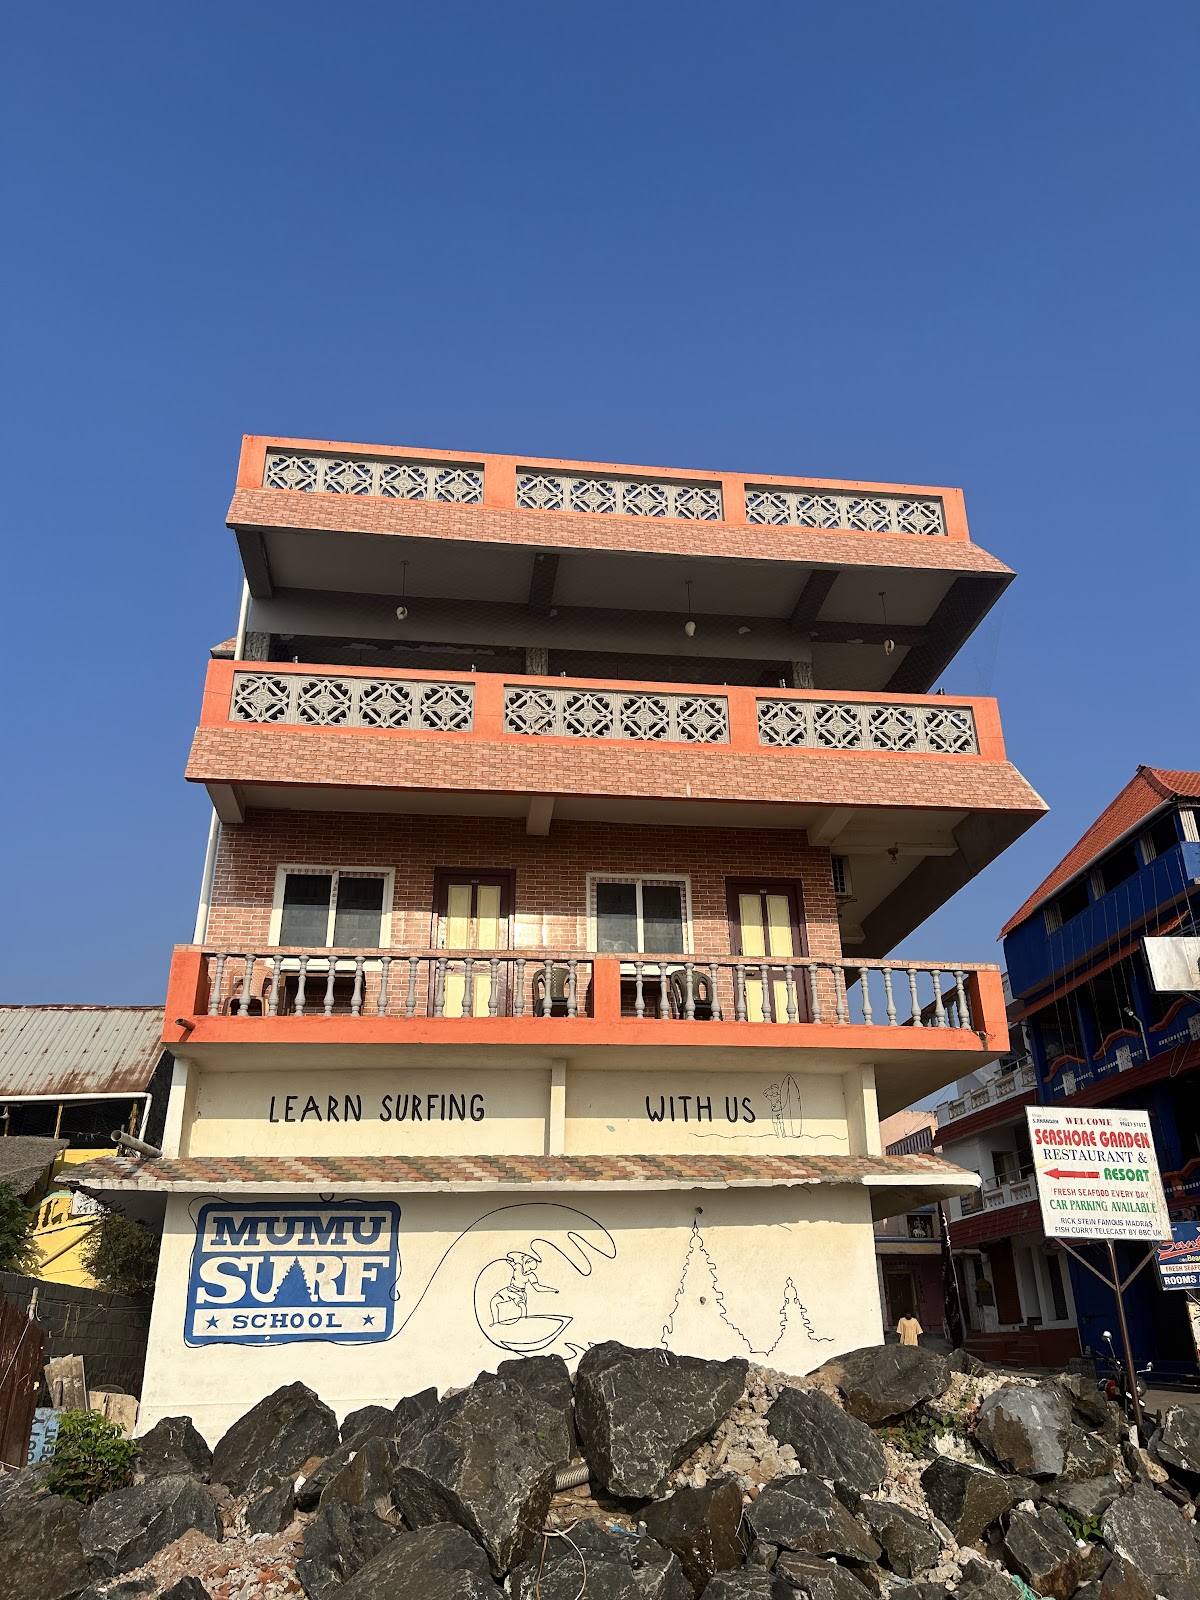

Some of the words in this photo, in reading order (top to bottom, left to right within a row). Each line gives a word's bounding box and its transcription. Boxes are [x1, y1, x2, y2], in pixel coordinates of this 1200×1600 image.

[269, 1095, 363, 1123] LEARN
[379, 1093, 485, 1122] SURFING
[645, 1095, 713, 1123] WITH
[725, 1096, 756, 1123] US
[1065, 1117, 1113, 1127] WELCOME
[1034, 1129, 1097, 1147] SEASHORE
[1099, 1131, 1151, 1149] GARDEN
[1043, 1148, 1134, 1163] RESTAURANT
[1137, 1152, 1148, 1164] &
[1103, 1167, 1150, 1182] RESORT
[1053, 1188, 1076, 1196] FRESH
[1078, 1189, 1110, 1197] SEAFOOD
[1111, 1190, 1134, 1198] EVERY
[1135, 1191, 1149, 1199] DAY
[1049, 1199, 1069, 1210] CAR
[1070, 1200, 1108, 1212] PARKING
[1111, 1201, 1157, 1214] AVAILABLE
[1060, 1217, 1076, 1225] RICK
[1126, 1220, 1153, 1228] MADRAS
[210, 1216, 387, 1246] MUMU
[1095, 1227, 1127, 1235] TELECAST
[196, 1255, 390, 1304] SURF
[1163, 1275, 1197, 1285] ROOMS
[232, 1313, 342, 1329] SCHOOL
